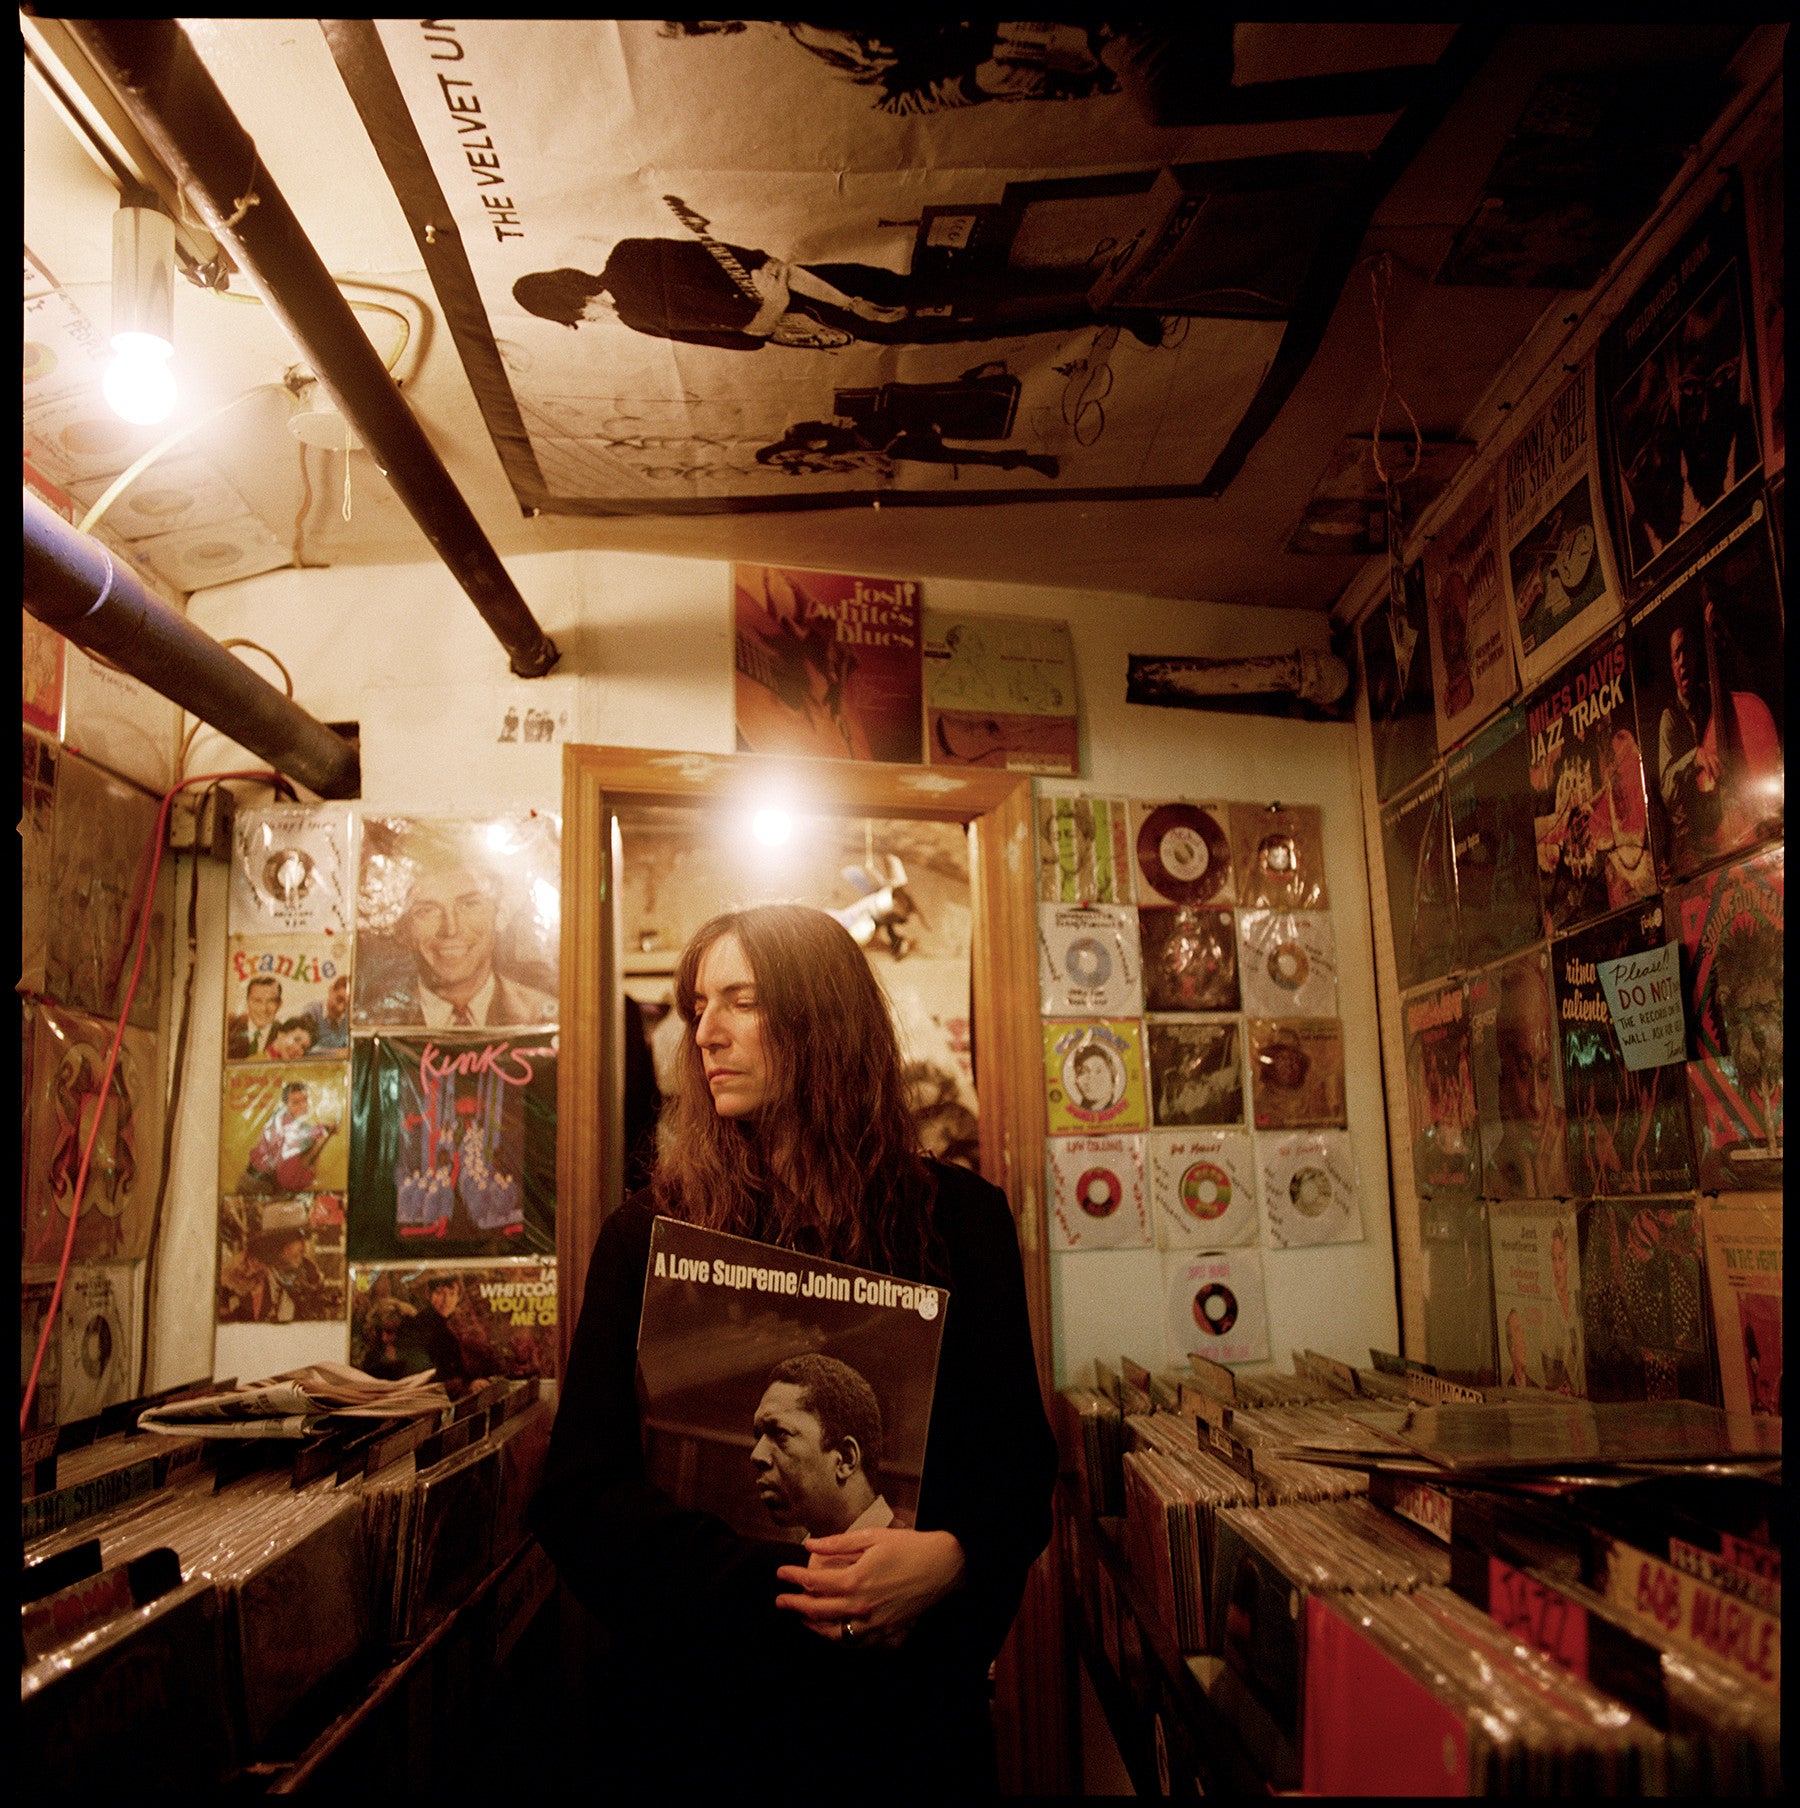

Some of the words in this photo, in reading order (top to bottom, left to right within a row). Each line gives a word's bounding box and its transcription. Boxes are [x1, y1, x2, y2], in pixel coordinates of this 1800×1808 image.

[437, 73, 505, 186] VELVET
[481, 194, 525, 243] THE
[1559, 409, 1588, 465] GETZ
[835, 619, 915, 648] blues
[1529, 684, 1572, 738] MILES
[1575, 643, 1626, 696] DAVIS
[1531, 716, 1565, 766] JAZZ
[1569, 673, 1625, 736] TRACK
[233, 951, 337, 983] frankie
[1562, 988, 1614, 1024] caliente
[1618, 985, 1646, 1010] DO
[1650, 977, 1673, 1004] NOT
[654, 1252, 666, 1278] A
[669, 1253, 710, 1284] Love
[489, 1297, 525, 1312] YOU
[510, 1311, 536, 1326] ME
[73, 1470, 132, 1518] STONES
[1636, 1562, 1681, 1630] BOB
